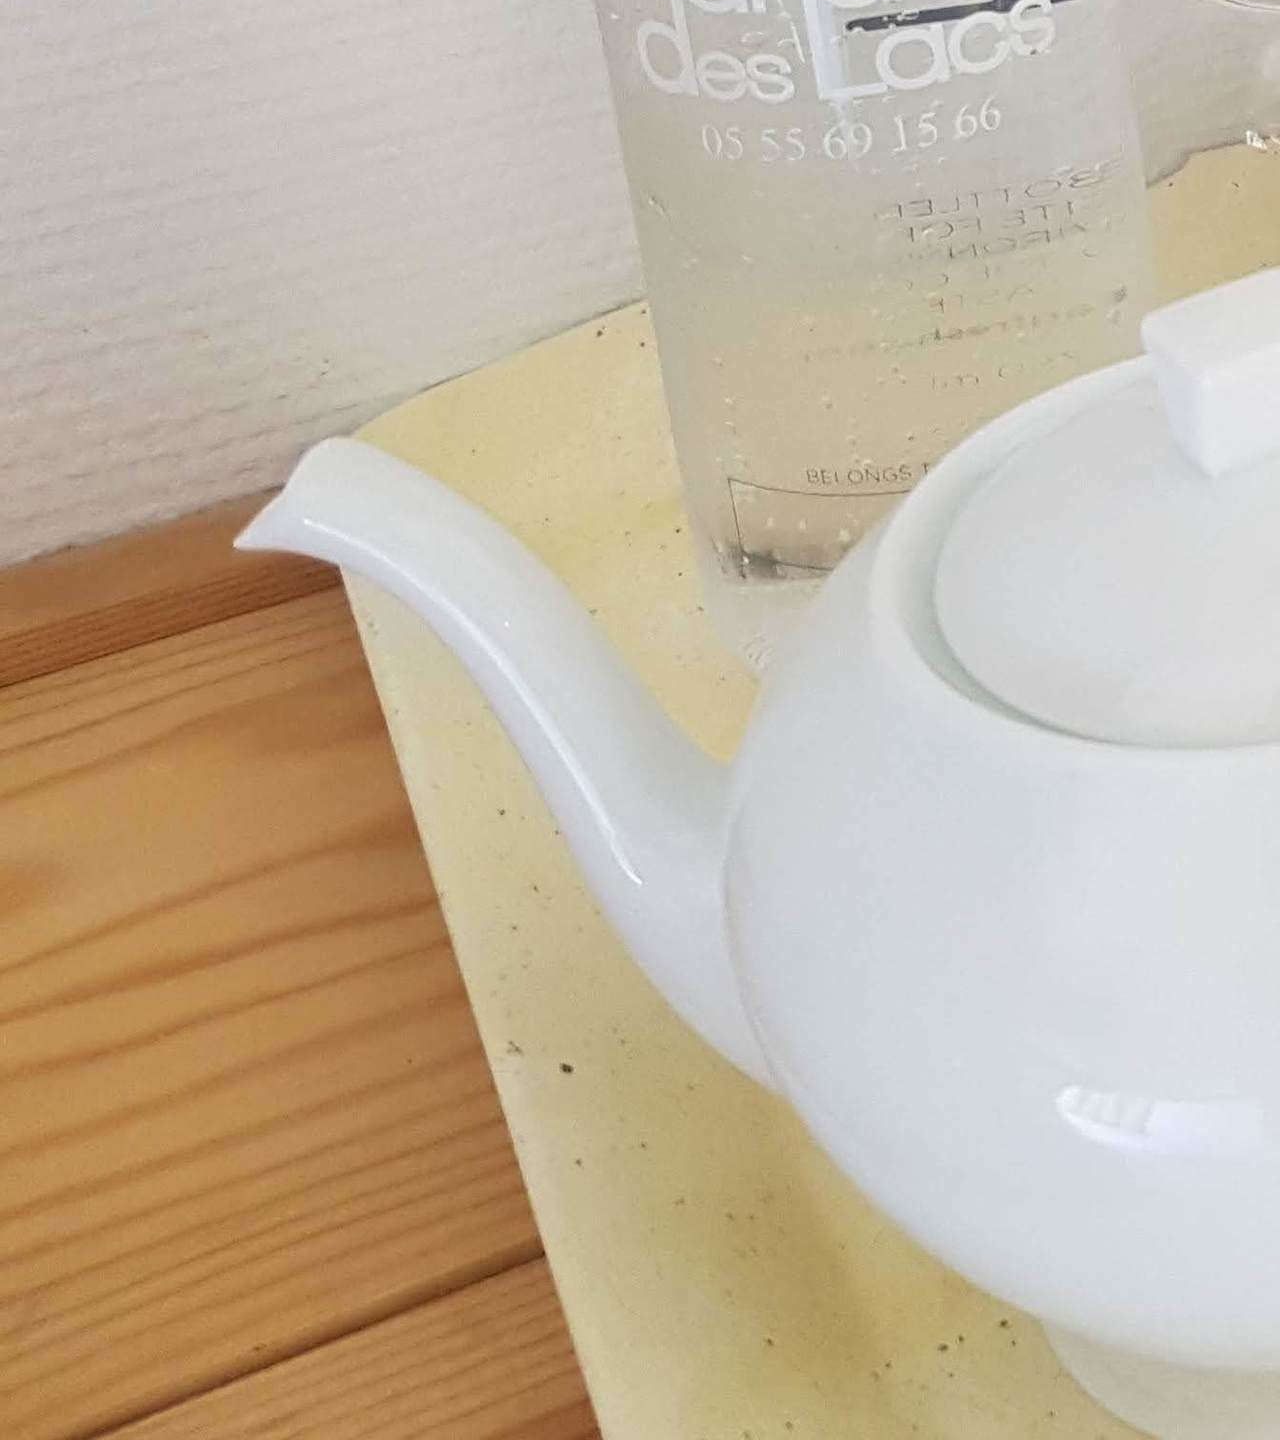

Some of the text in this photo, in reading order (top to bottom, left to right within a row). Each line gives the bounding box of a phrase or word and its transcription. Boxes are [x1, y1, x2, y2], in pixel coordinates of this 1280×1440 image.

[701, 97, 1002, 161] 05 55 69 15 66
[805, 466, 913, 486] BELONGS
